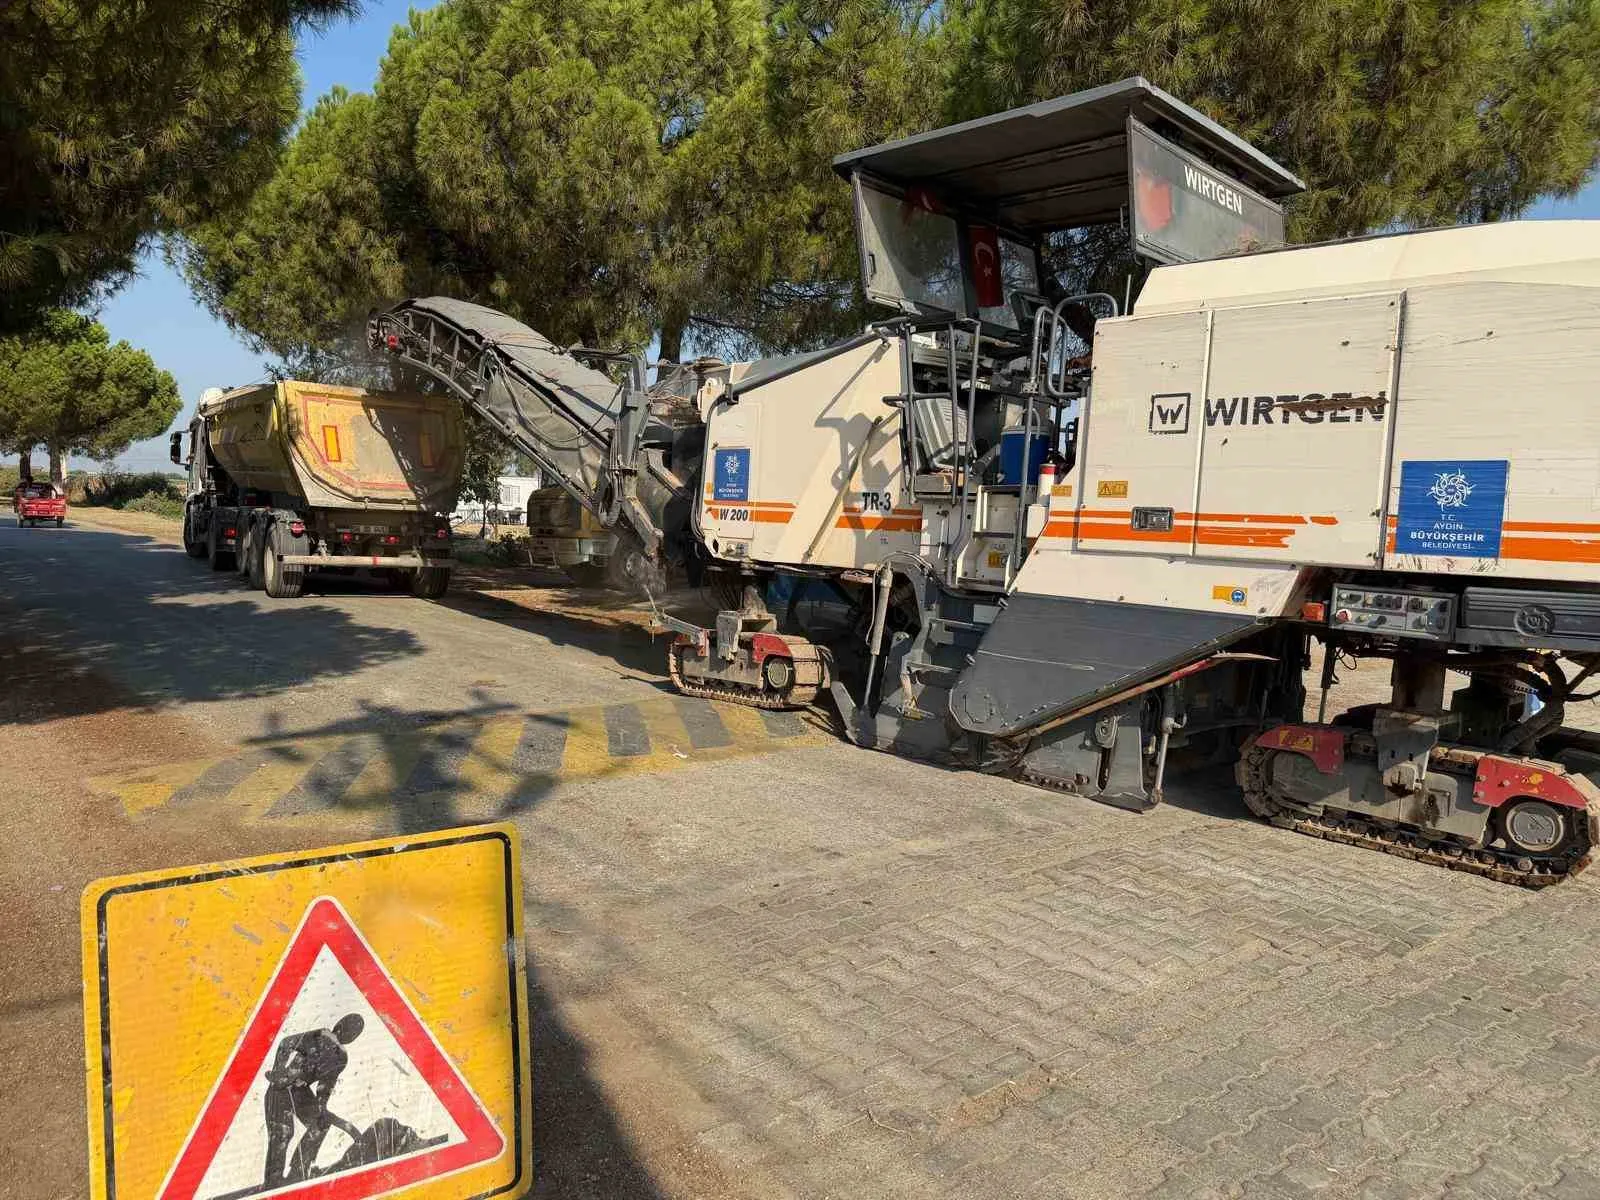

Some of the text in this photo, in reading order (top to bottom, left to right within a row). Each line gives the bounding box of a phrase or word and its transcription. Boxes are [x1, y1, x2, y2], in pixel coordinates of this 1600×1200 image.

[1184, 165, 1242, 215] WIRTGEN
[862, 492, 891, 511] TR-3
[719, 508, 749, 521] W 200
[1410, 530, 1485, 542] BÜYÜKŞEHİR
